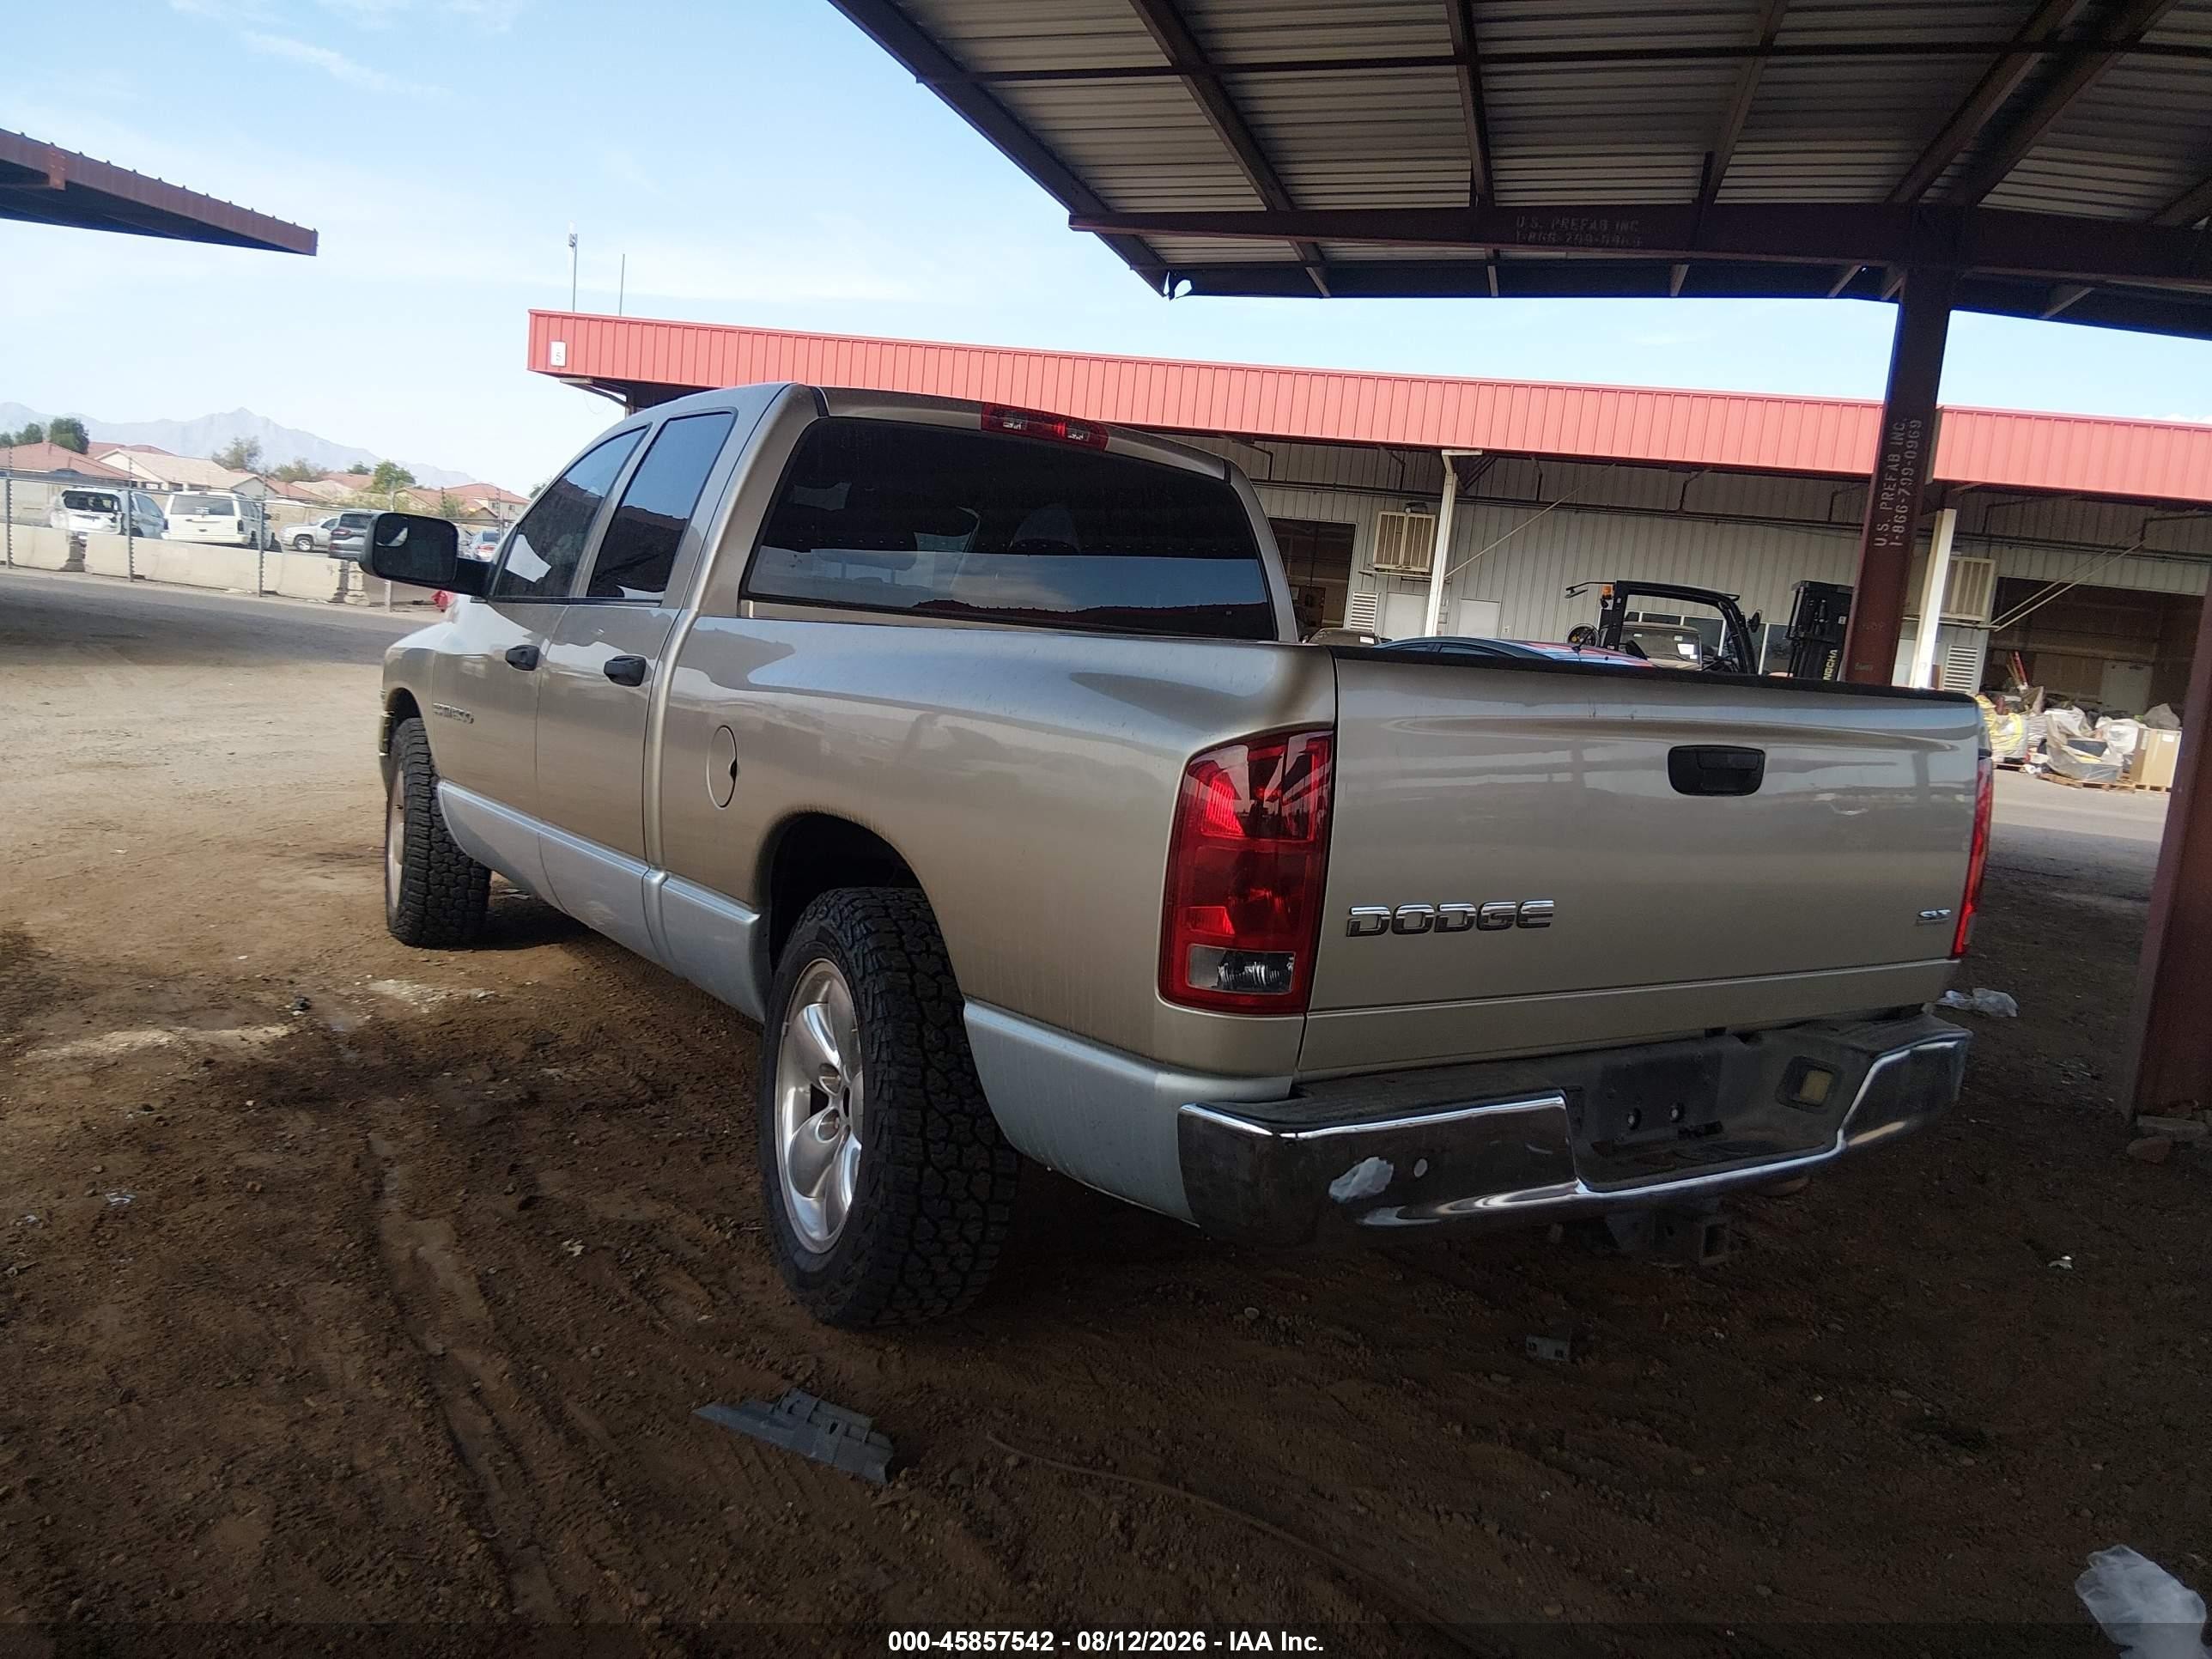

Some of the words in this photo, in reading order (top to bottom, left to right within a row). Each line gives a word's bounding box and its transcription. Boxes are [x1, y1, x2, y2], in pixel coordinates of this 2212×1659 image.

[1551, 217, 1608, 232] PREFAB
[1880, 453, 1901, 511] PREFAB
[1889, 419, 1923, 546] 1-866-799-0969
[1874, 518, 1890, 547] U.S.
[1346, 898, 1555, 937] DODGE
